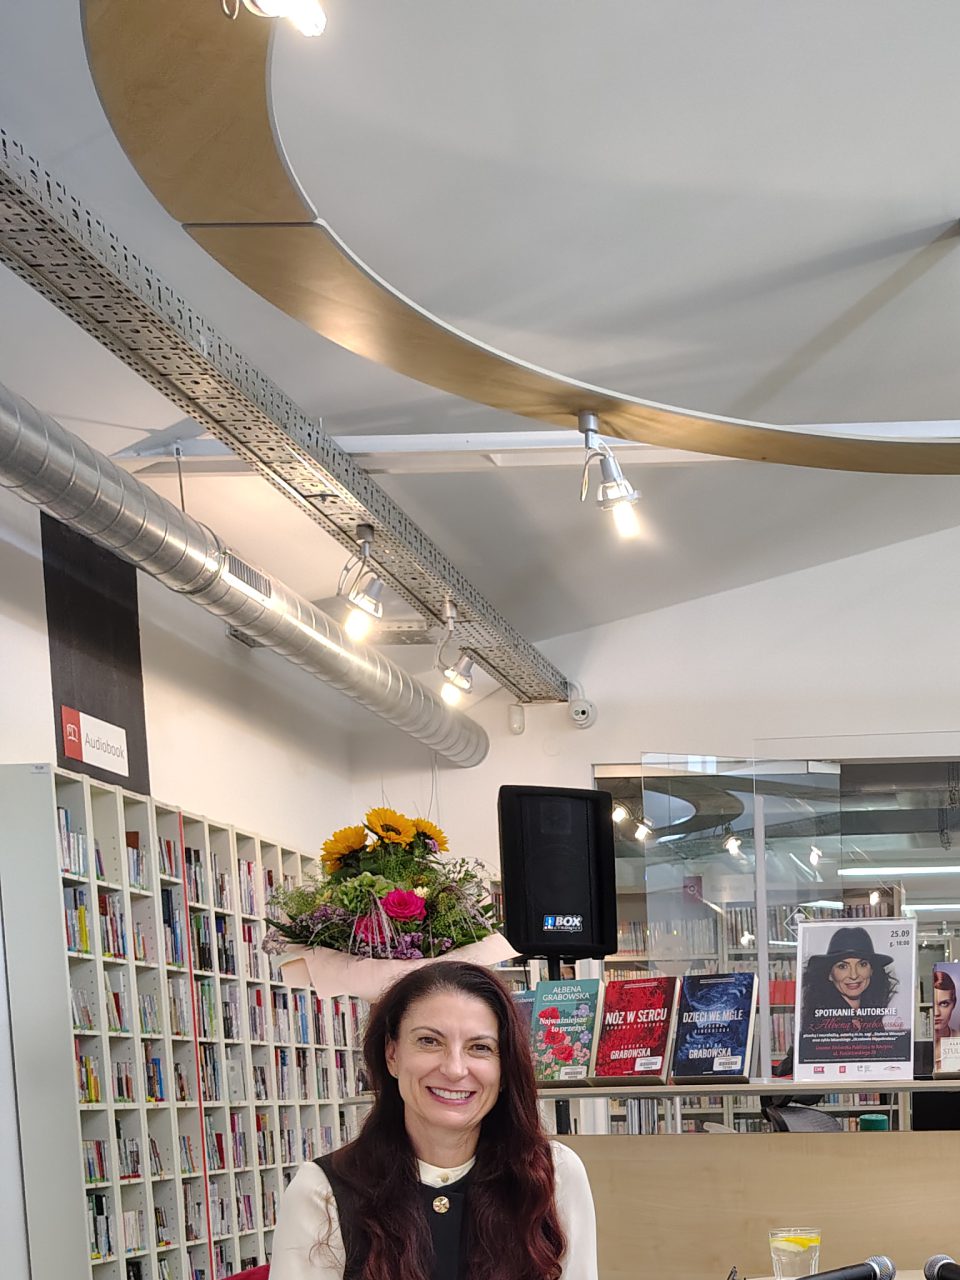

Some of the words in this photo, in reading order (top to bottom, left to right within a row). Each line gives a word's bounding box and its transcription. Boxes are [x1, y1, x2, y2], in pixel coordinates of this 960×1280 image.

[85, 732, 125, 760] Audiobook
[890, 930, 910, 938] 25.09
[552, 985, 582, 994] AŁBENA
[542, 992, 590, 1001] GRABOWSKA
[605, 1009, 626, 1025] NÓŻ
[626, 1011, 636, 1023] W
[637, 1008, 668, 1023] SERCU
[682, 1011, 707, 1023] DZIECI
[708, 1010, 721, 1021] WE
[722, 1009, 744, 1020] MGLE
[814, 1008, 855, 1017] SPOTKANIE
[856, 1007, 897, 1016] AUTORSKIE
[539, 1016, 588, 1026] Najważniejsze
[610, 1047, 651, 1060] GRABOWSKA
[689, 1047, 732, 1059] GRABOWSKA
